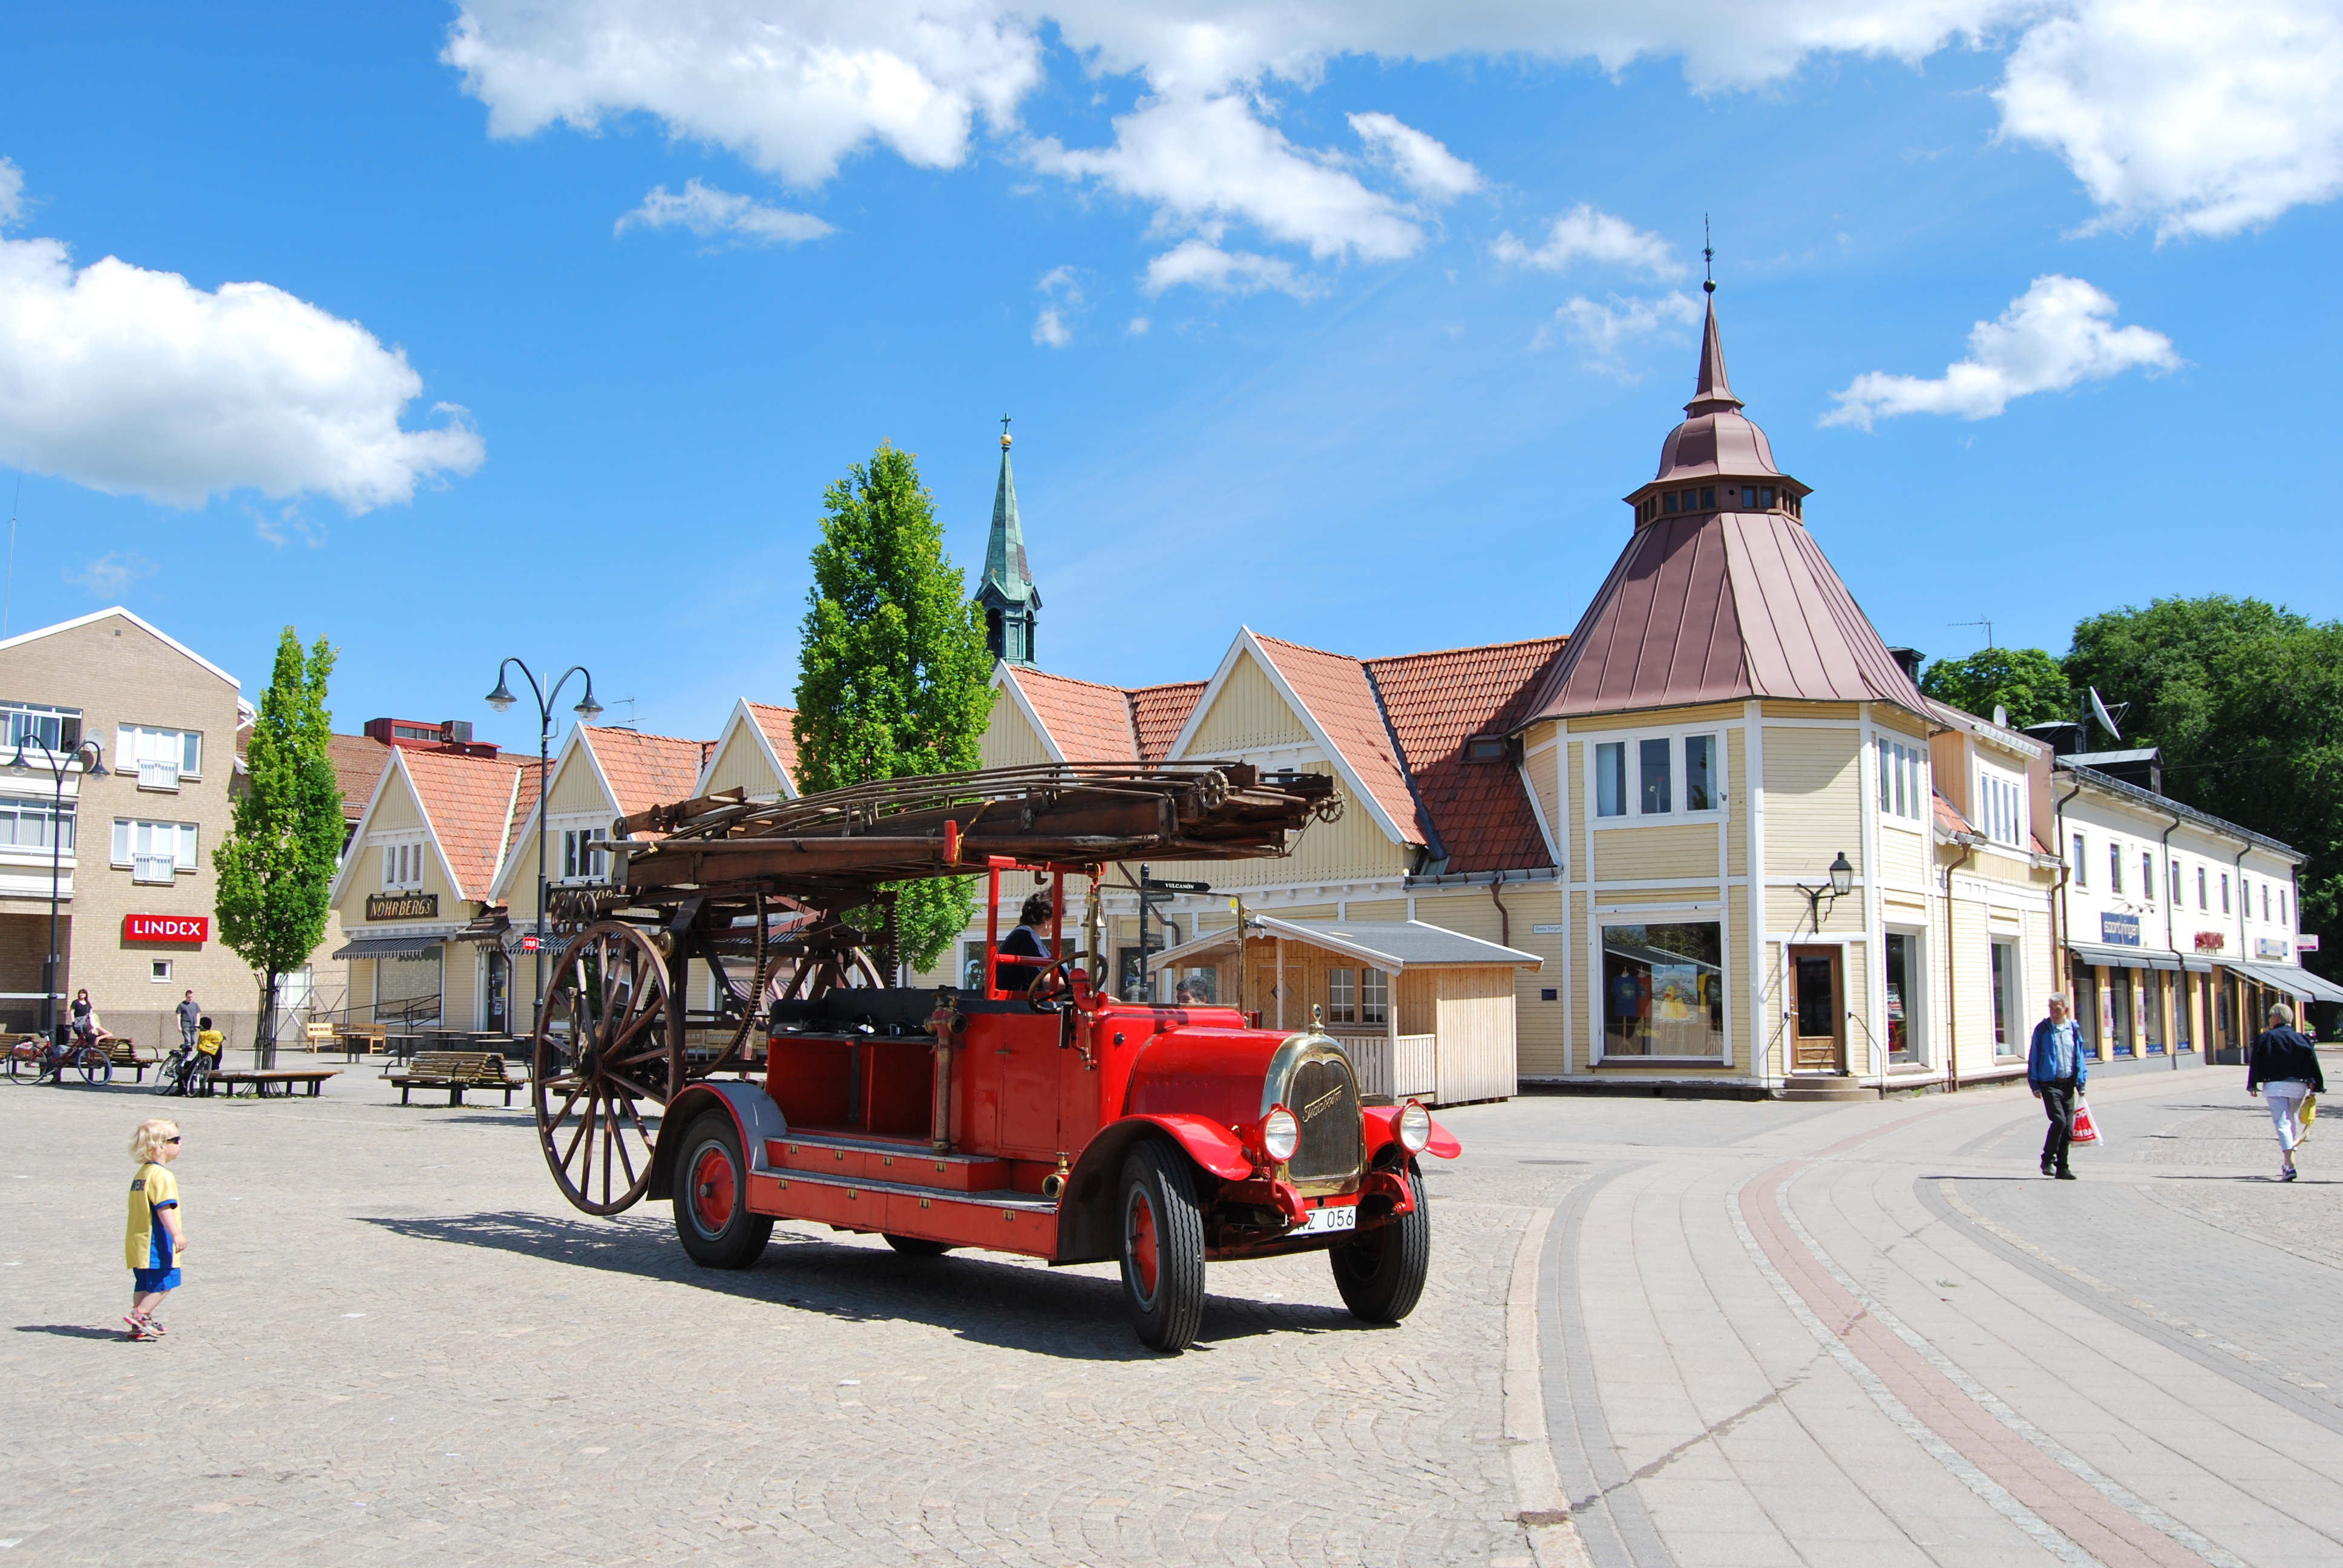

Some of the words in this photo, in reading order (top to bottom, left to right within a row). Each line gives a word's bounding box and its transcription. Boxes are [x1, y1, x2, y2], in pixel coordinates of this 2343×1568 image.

[370, 899, 432, 917] NOHRBERGS
[133, 920, 200, 936] LINDEX
[1327, 1209, 1354, 1228] 056
